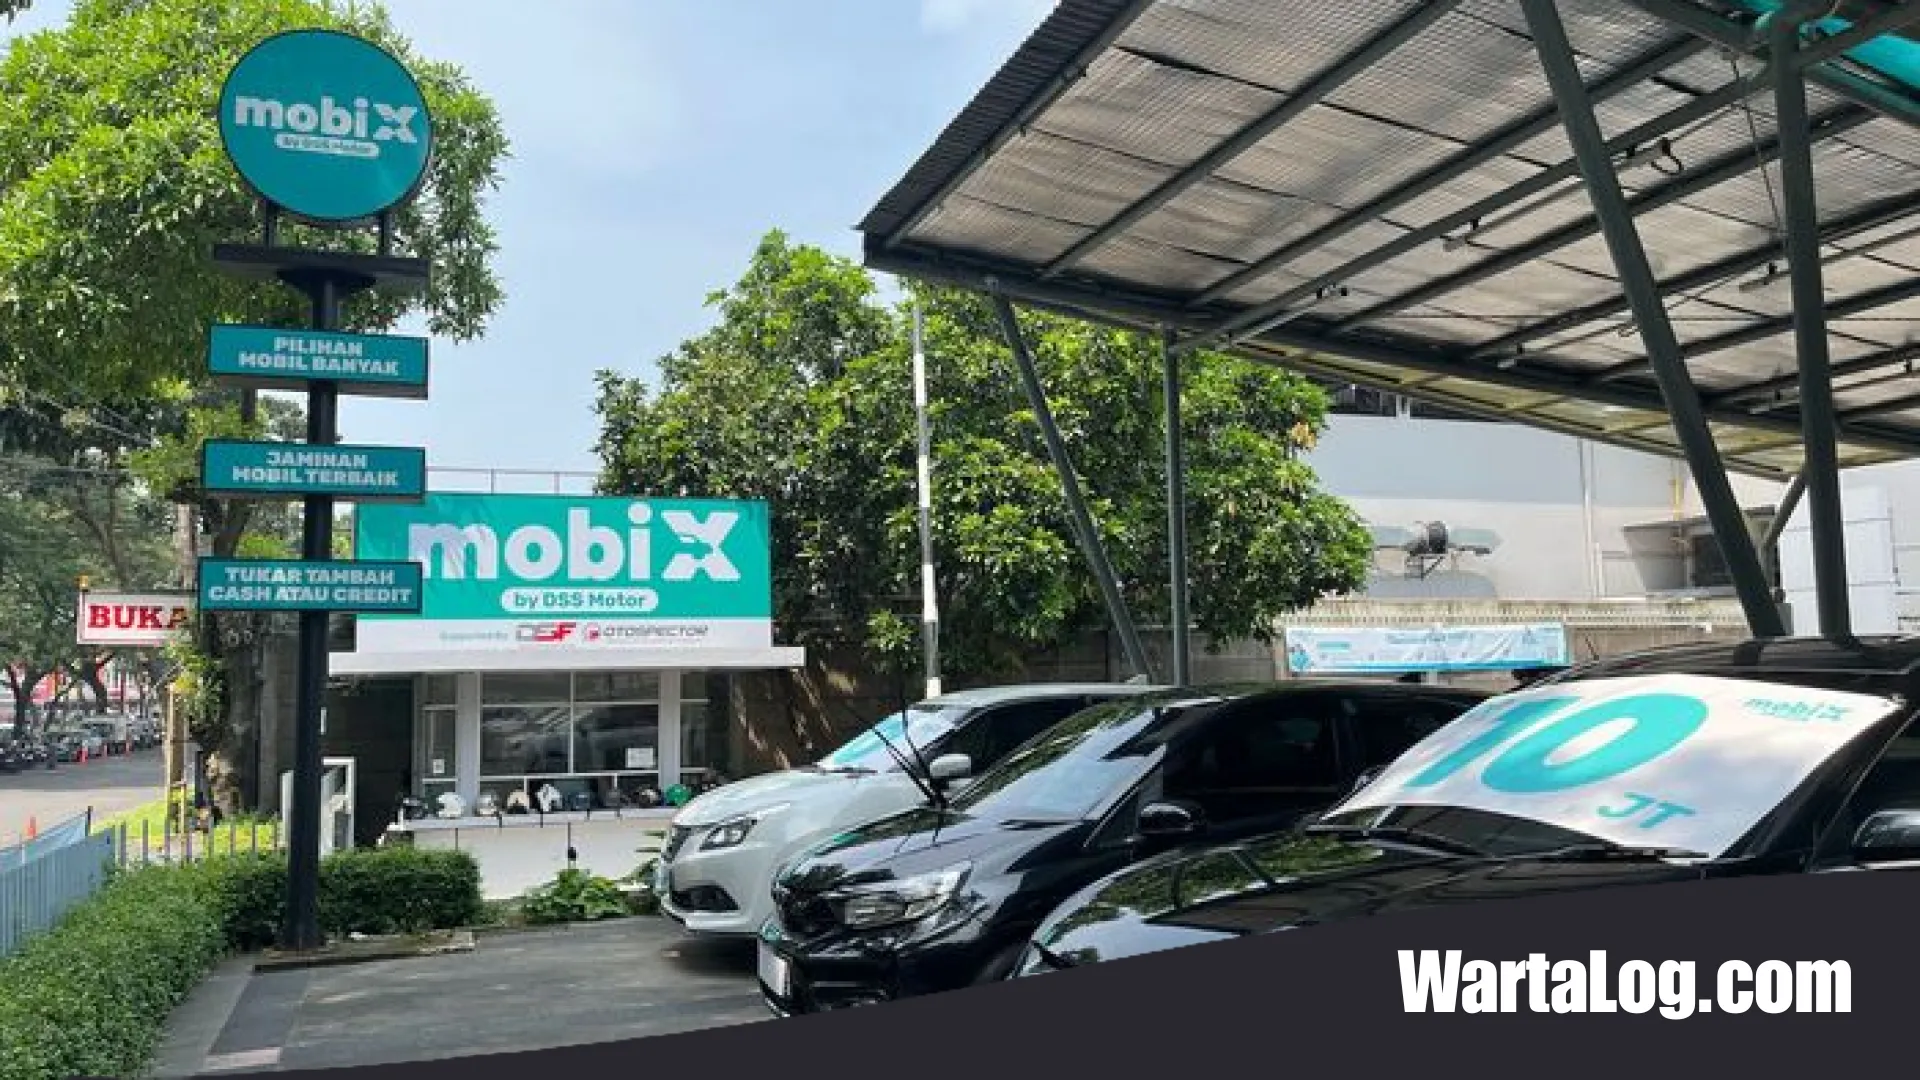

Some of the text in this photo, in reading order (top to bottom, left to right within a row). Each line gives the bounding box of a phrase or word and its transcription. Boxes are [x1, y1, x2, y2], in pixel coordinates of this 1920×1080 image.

[274, 337, 363, 356] PILIHAN
[238, 351, 399, 376] MOBIL BANYAK
[266, 452, 368, 469] JAMINAN
[232, 466, 398, 486] MOBIL TERBAIK
[225, 567, 396, 584] TUKAR TAMBAH
[208, 586, 412, 603] CASH ATAU CREDIT
[515, 592, 646, 608] by DSS Motor
[1403, 694, 1709, 793] 10
[1596, 793, 1695, 828] JT
